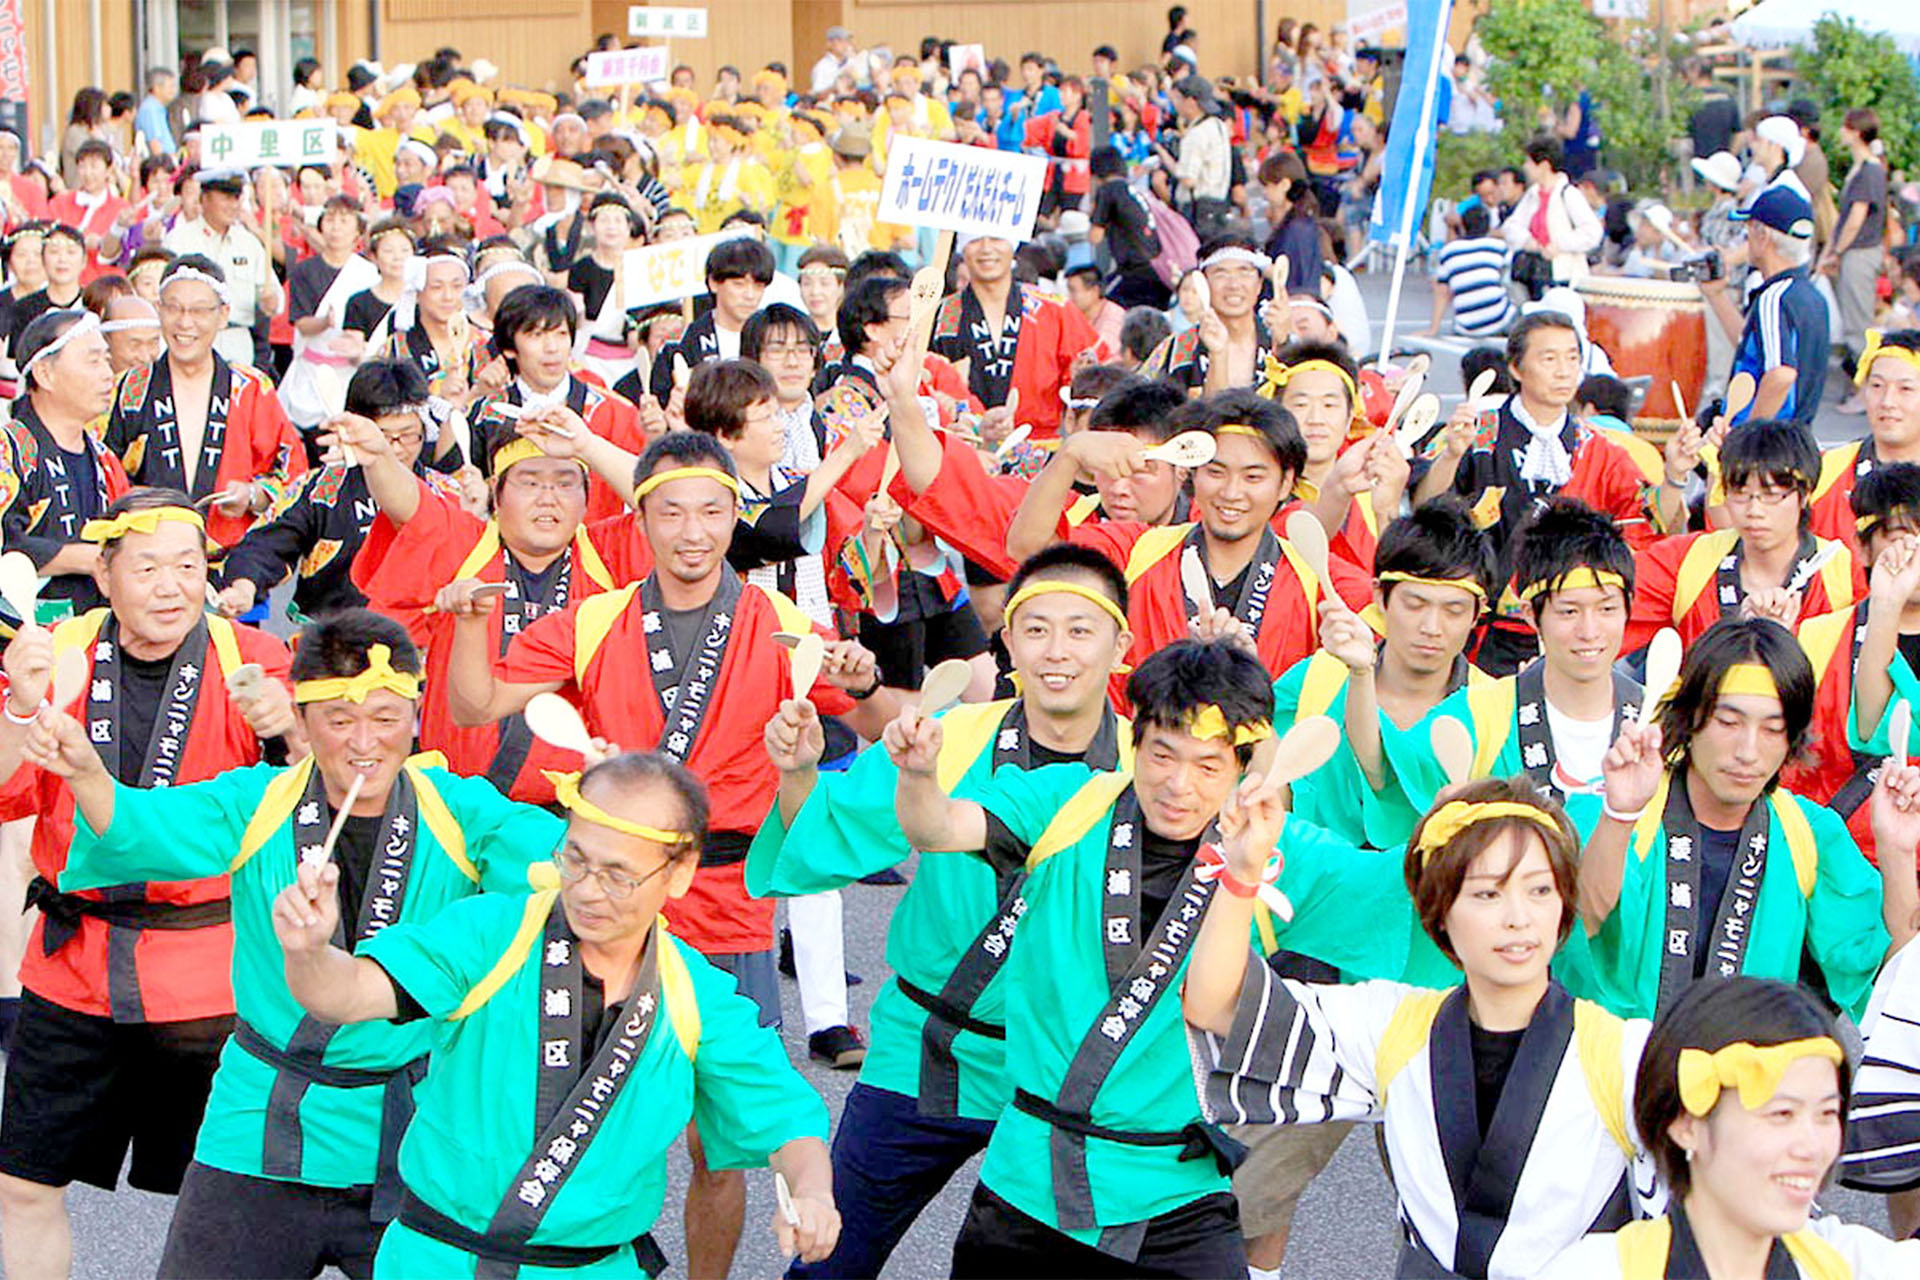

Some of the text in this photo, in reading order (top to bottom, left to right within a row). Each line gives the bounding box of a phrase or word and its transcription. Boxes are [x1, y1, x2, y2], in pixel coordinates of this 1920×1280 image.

[211, 127, 325, 161] 中里区
[997, 315, 1021, 376] NTT
[154, 397, 180, 469] NTT
[203, 396, 229, 467] NTT
[45, 456, 76, 537] NTT
[662, 612, 732, 764] キンニャモニャ保
[1717, 833, 1767, 979] キンニャモニャ
[517, 992, 656, 1209] キンニャモニャ保存会
